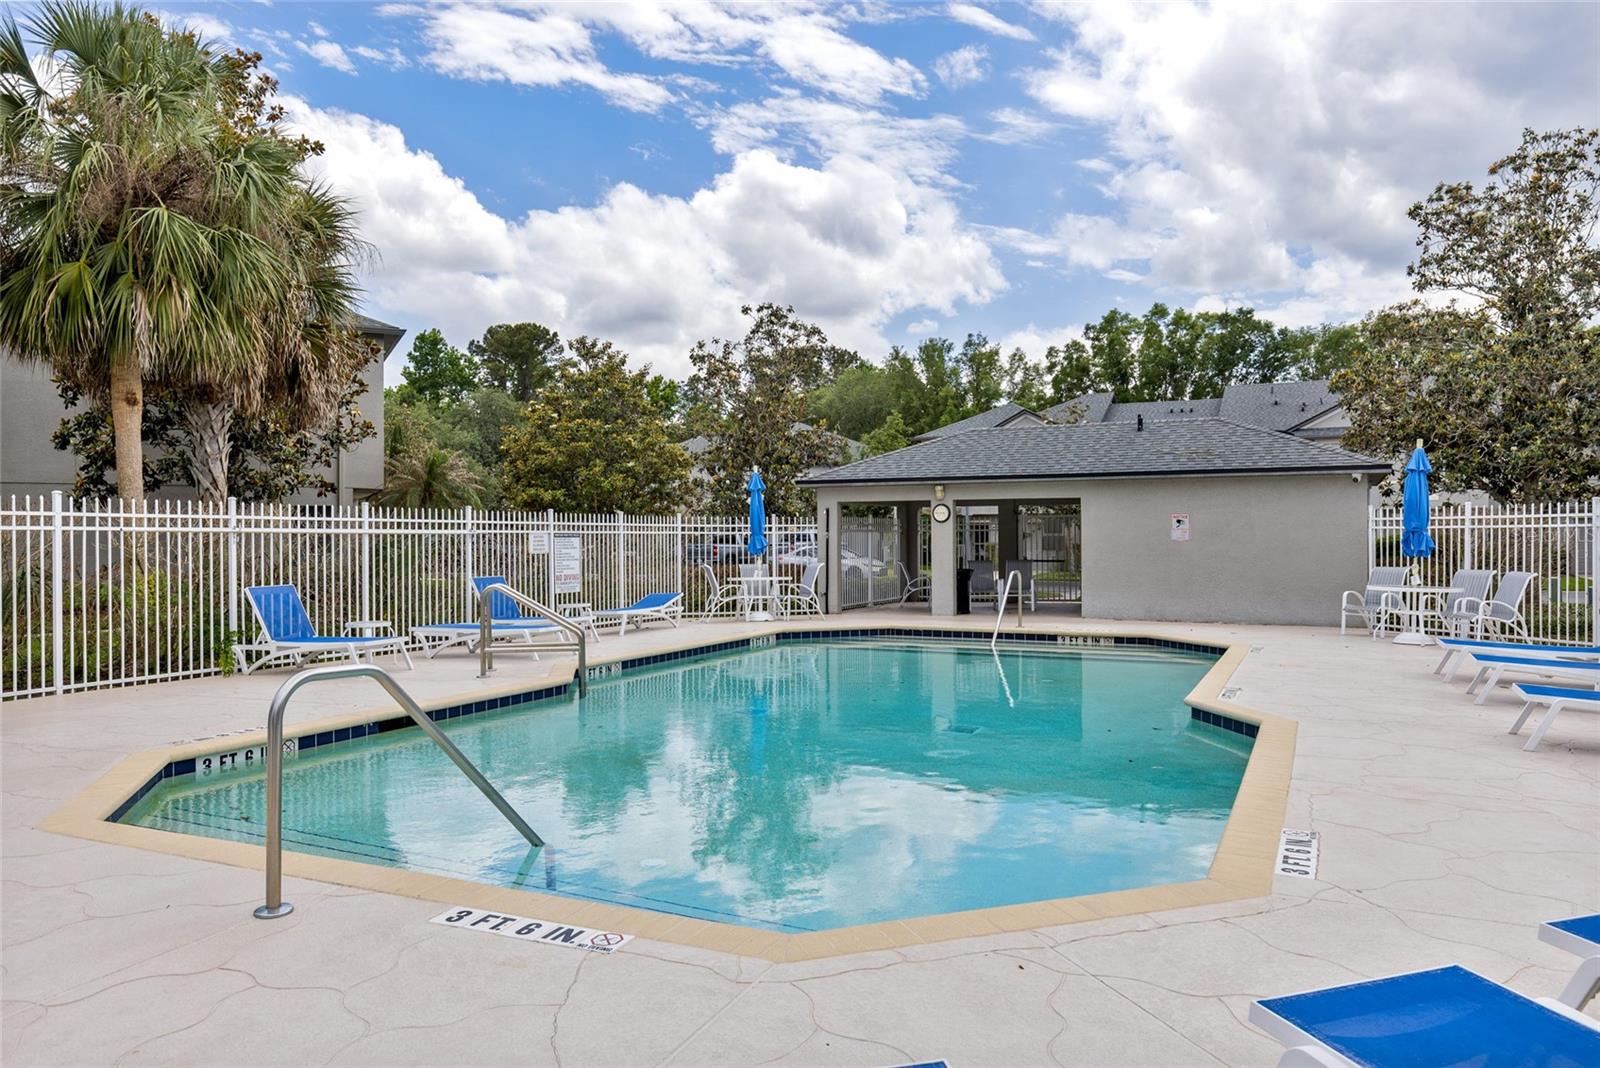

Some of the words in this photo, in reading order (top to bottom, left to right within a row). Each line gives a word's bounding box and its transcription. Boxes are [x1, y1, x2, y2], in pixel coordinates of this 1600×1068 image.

[202, 757, 212, 769] 3
[244, 748, 255, 761] 6
[1284, 847, 1312, 855] 6
[1280, 867, 1310, 876] 3
[445, 910, 473, 923] 3
[470, 914, 517, 931] FT.
[515, 922, 543, 936] 6
[541, 926, 586, 944] IN.
